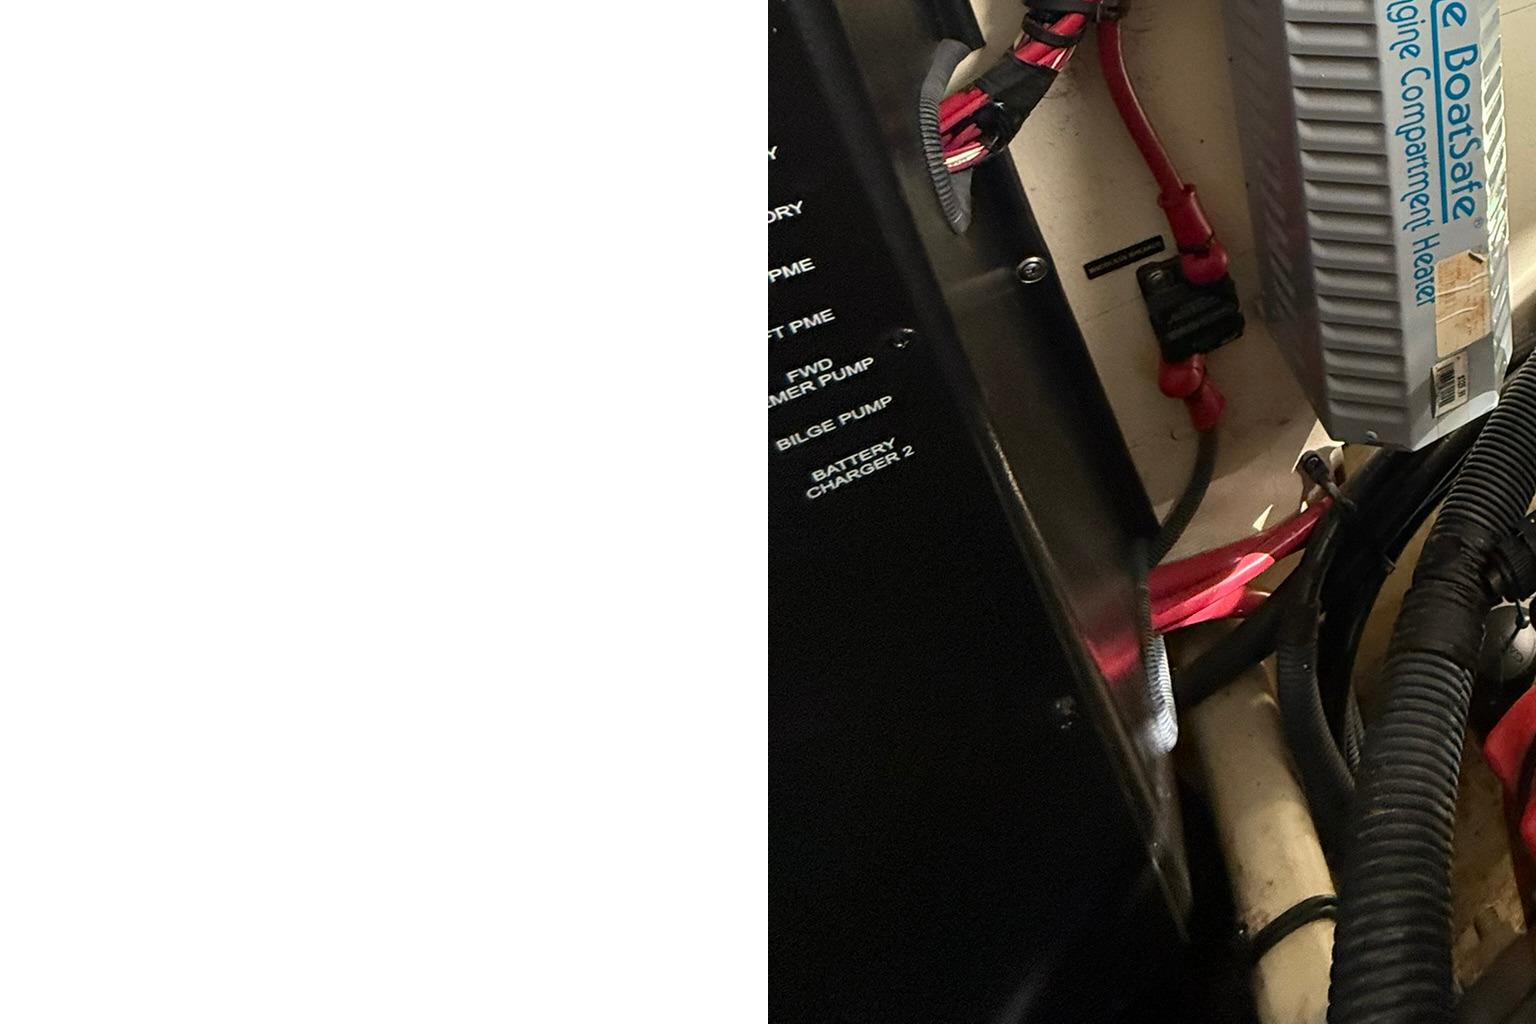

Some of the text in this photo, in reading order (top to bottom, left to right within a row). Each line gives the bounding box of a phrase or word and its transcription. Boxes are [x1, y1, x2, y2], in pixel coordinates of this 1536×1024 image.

[1395, 67, 1435, 232] Compartment
[1444, 43, 1483, 220] BoatSafe
[768, 258, 816, 283] PME
[1412, 232, 1441, 307] Heater
[788, 308, 836, 334] PME
[768, 357, 874, 409] MER PUMP
[786, 358, 833, 383] FWD
[775, 395, 893, 451] BILGE PUMP
[806, 445, 915, 499] CHARGER 2
[811, 437, 896, 482] BATTERY
